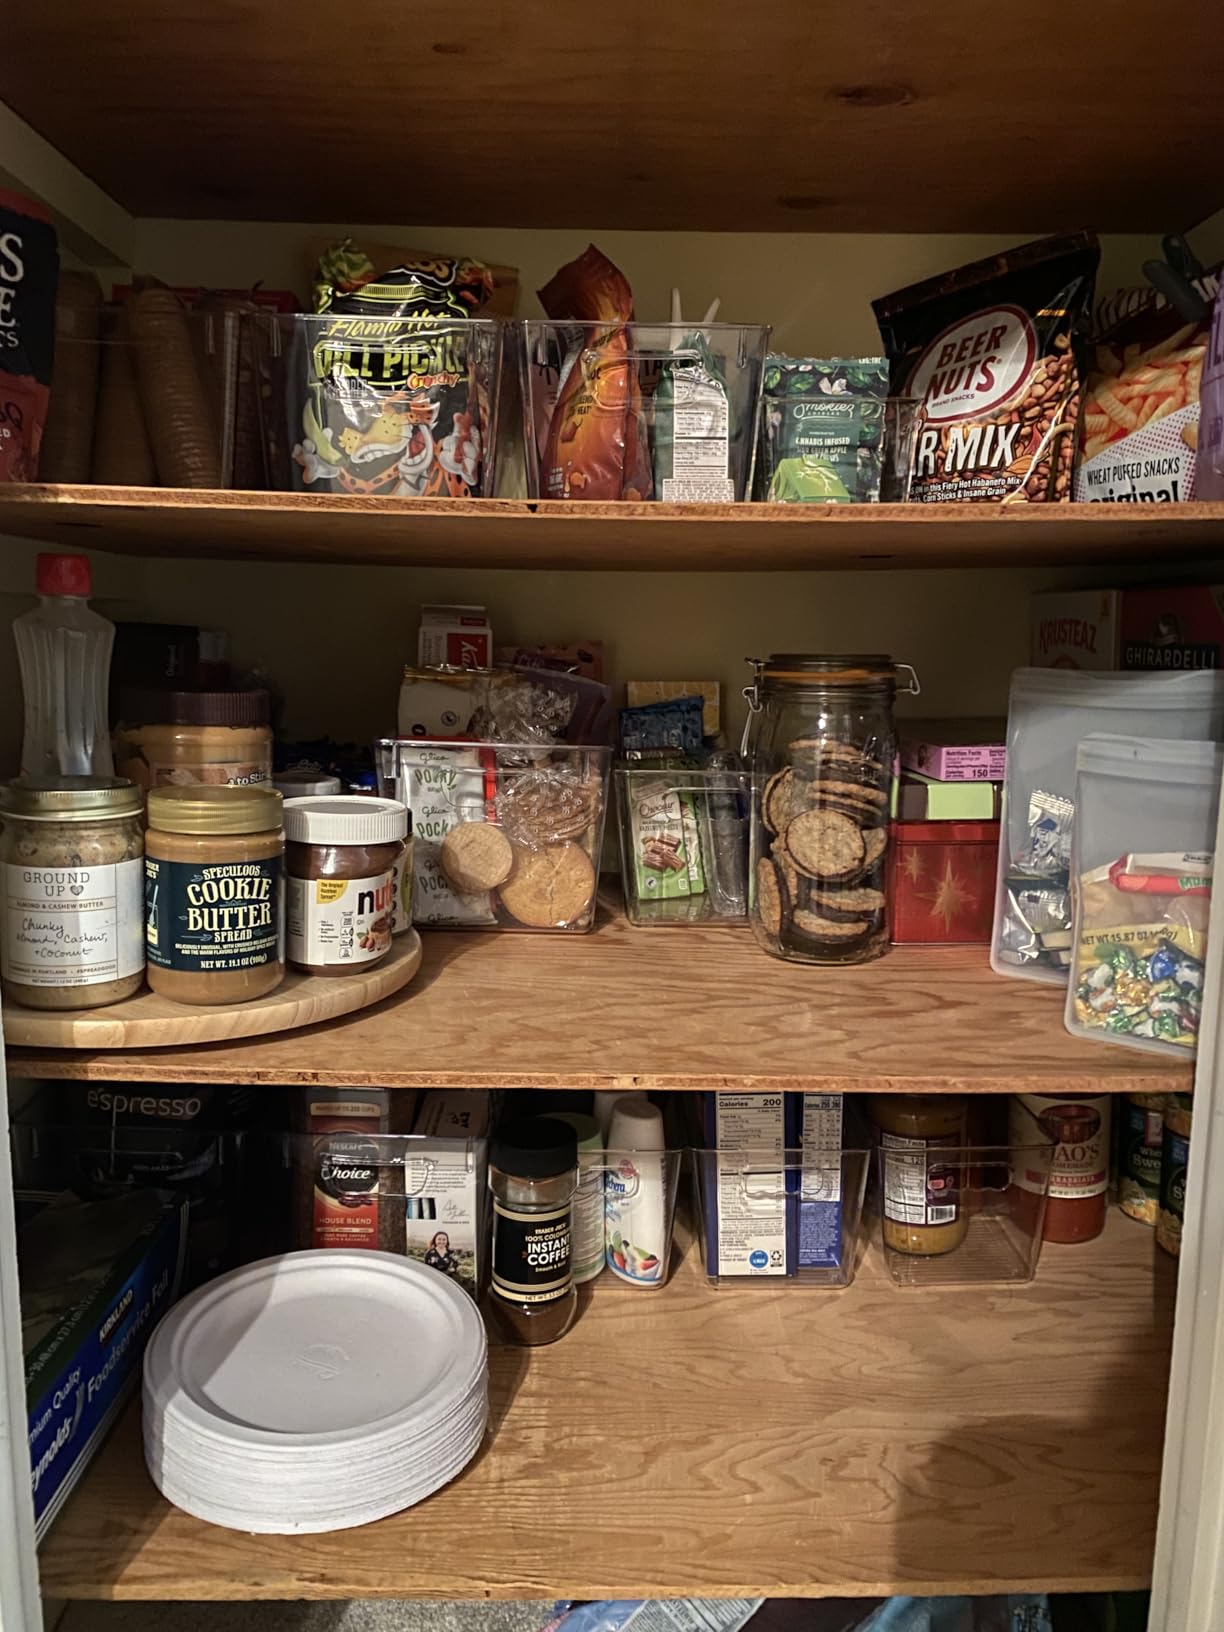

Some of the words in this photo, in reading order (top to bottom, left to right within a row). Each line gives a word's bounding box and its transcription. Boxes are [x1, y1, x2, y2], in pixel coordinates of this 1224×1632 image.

[408, 308, 452, 331] Hot
[936, 325, 1008, 369] BEER
[925, 355, 995, 400] NUTS
[951, 393, 975, 403] SNACKS
[825, 436, 850, 445] INFUSED
[945, 423, 1020, 472] MIX
[1087, 467, 1111, 486] WHEAT
[1112, 462, 1142, 484] PUFFED
[1143, 456, 1181, 479] SNACKS
[923, 494, 937, 502] Corn
[937, 491, 957, 500] Sticks
[963, 488, 985, 497] Insane
[987, 487, 1006, 496] Grain
[930, 484, 942, 493] this
[942, 482, 958, 492] Fiery
[959, 479, 971, 488] Hot
[972, 477, 1006, 487] Habanero
[1006, 477, 1020, 485] Mix
[1039, 617, 1098, 654] KRUSTEAZ
[1126, 647, 1216, 669] GHIRARDELLI
[972, 769, 988, 778] 150
[23, 872, 90, 884] GROUND
[202, 865, 261, 880] SPECULOOS
[45, 885, 65, 897] UP
[187, 877, 272, 906] COOKIE
[79, 901, 104, 909] BUTTER
[187, 902, 272, 931] BUTTER
[22, 918, 64, 939] Chunky
[214, 929, 252, 943] SPREAD
[1095, 933, 1110, 944] WT
[1111, 932, 1136, 943] 15.87
[201, 960, 214, 969] NET
[241, 957, 249, 966] OZ
[88, 1087, 201, 1117] espresso
[763, 1098, 782, 1106] 200
[346, 1217, 372, 1225] BLEND
[525, 1234, 544, 1242] 100%
[527, 1233, 570, 1253] INSTANT
[527, 1244, 570, 1266] COFFEE
[99, 1289, 133, 1344] KIRKLAND
[87, 1301, 150, 1403] Foodservice
[151, 1269, 169, 1303] Foil
[52, 1365, 81, 1410] Quality
